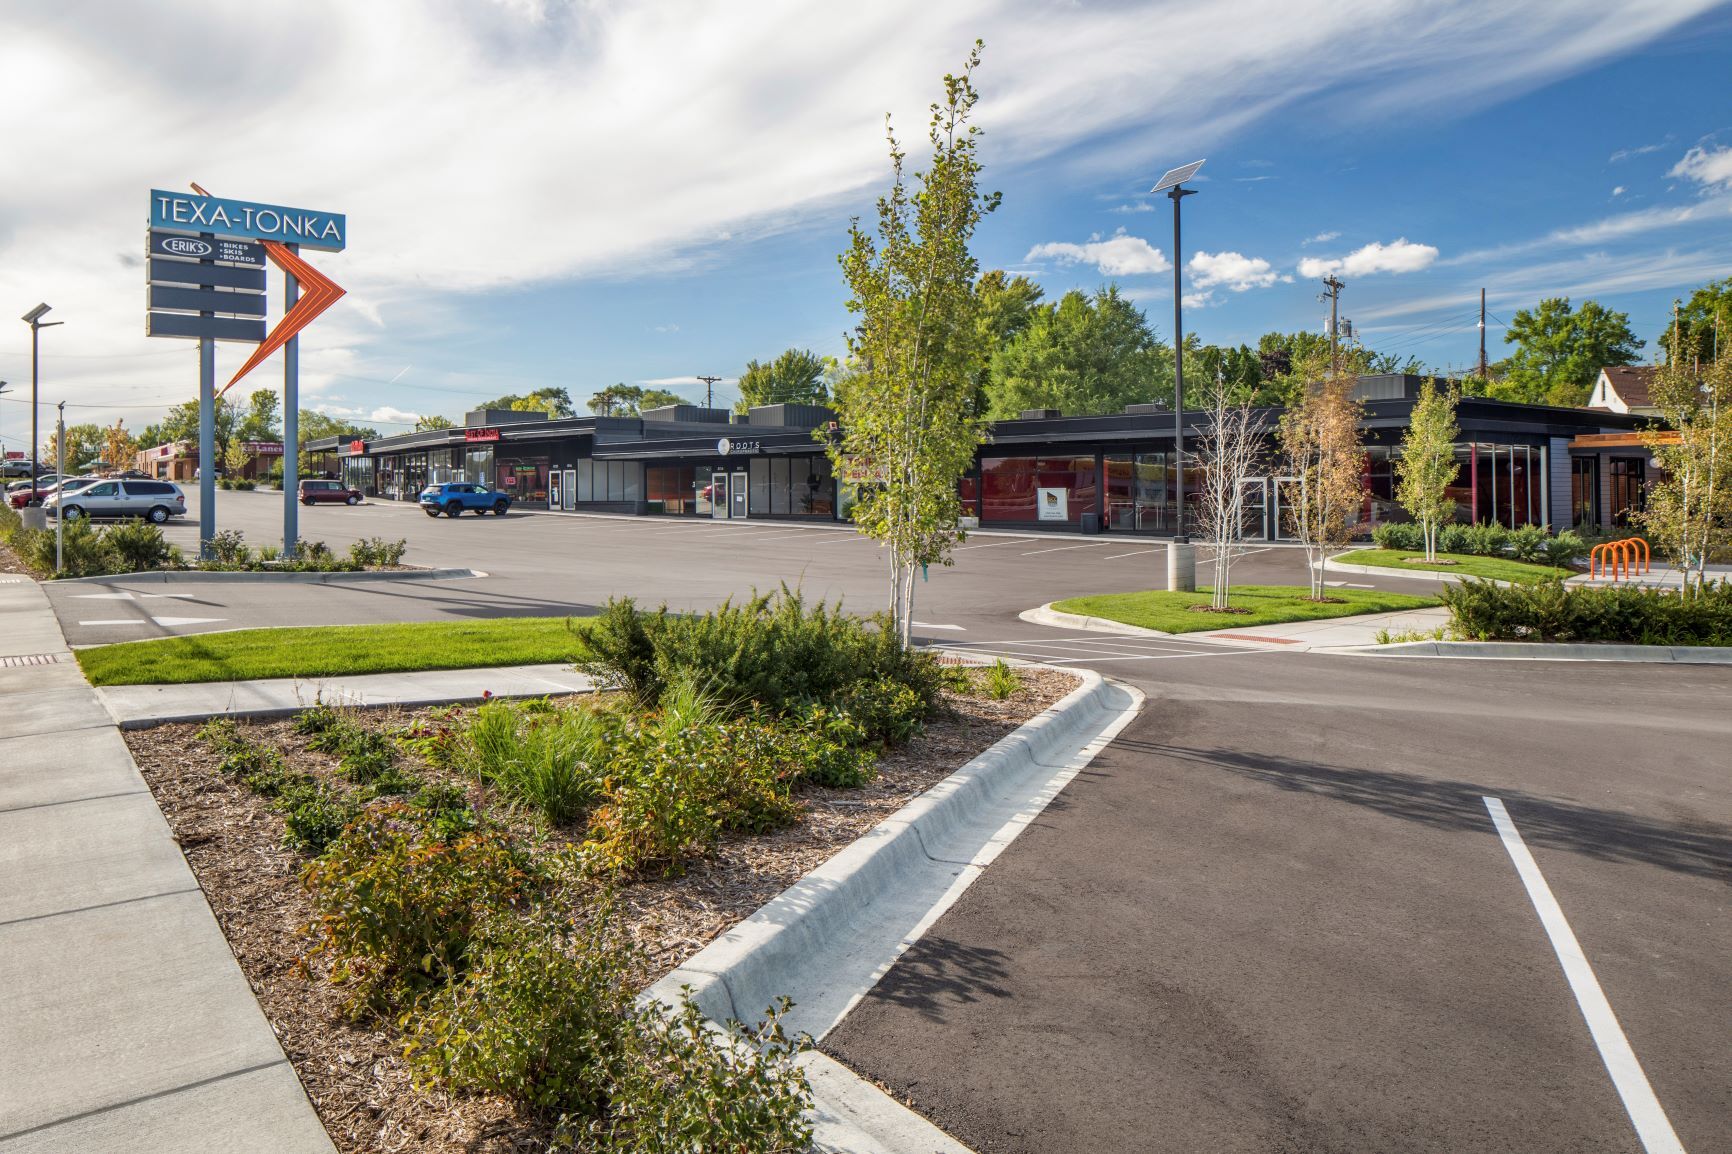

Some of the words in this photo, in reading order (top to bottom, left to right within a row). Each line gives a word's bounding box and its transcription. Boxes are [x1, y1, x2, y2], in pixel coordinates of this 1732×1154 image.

[157, 197, 341, 241] TEXA-TONKA
[171, 240, 205, 254] ERIK'S
[223, 242, 249, 251] BIKES
[223, 248, 244, 256] SKIS
[223, 254, 256, 263] BOARDS
[730, 441, 760, 450] ROOTS
